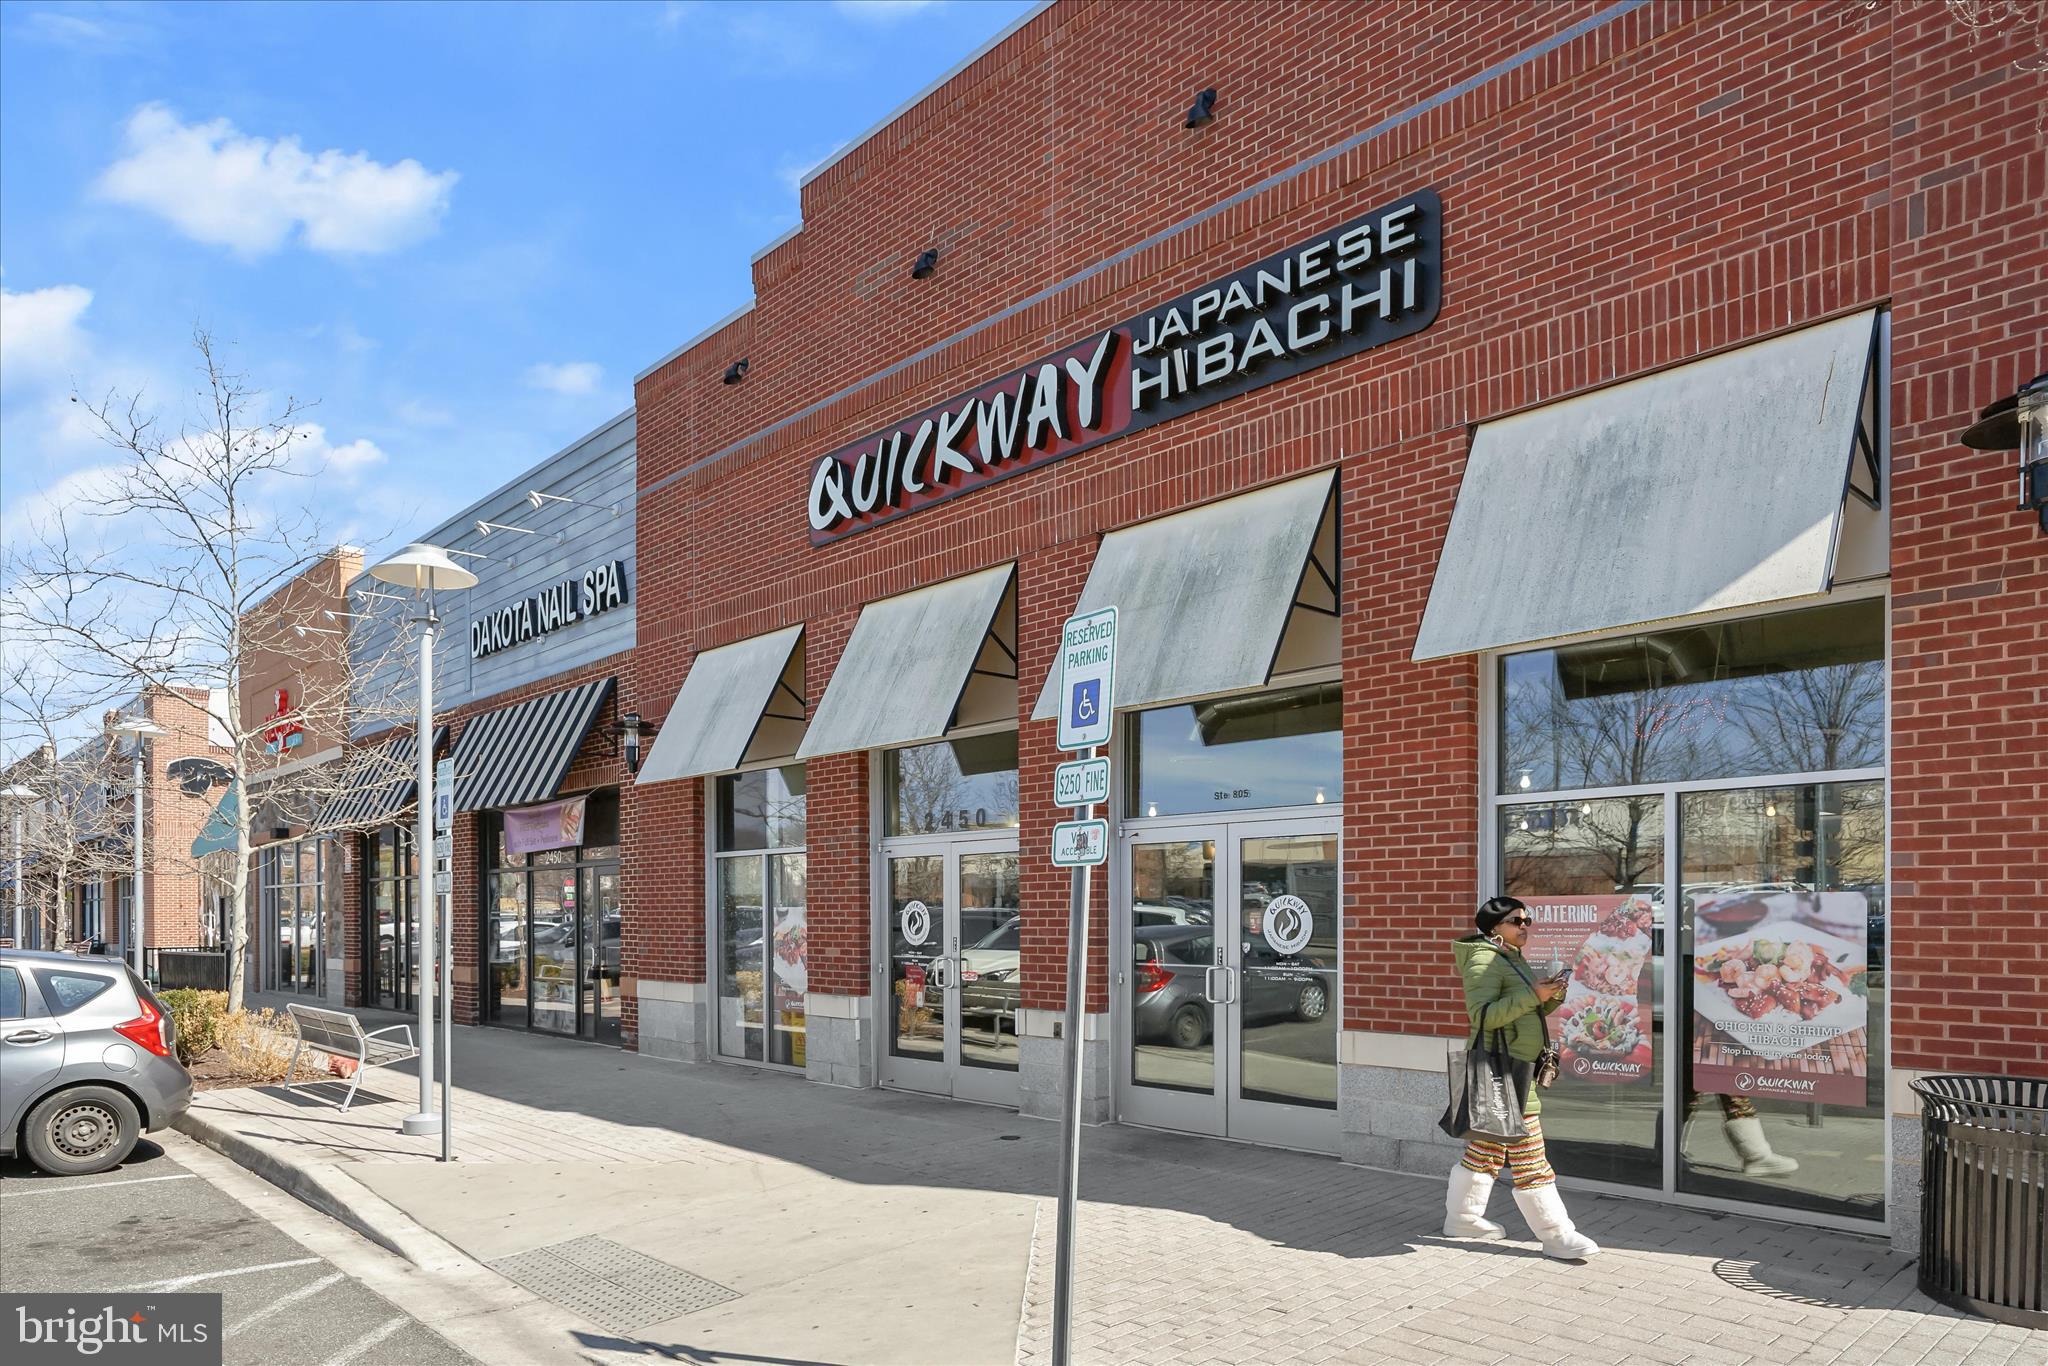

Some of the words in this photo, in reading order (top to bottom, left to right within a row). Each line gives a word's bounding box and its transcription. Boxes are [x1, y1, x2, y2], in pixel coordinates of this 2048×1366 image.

[1133, 204, 1416, 355] JAPANESE
[1131, 258, 1416, 410] HIBACHI
[808, 330, 1112, 530] QUICKWAY
[471, 597, 533, 659] DAKOTA
[537, 580, 577, 634] NAIL
[583, 560, 621, 616] SPA
[1066, 621, 1113, 648] RESERVED
[1068, 645, 1109, 669] PARKING
[1059, 773, 1081, 797] $250
[1085, 769, 1105, 792] FINE
[1232, 789, 1249, 798] 805
[924, 808, 986, 832] 2450
[545, 851, 562, 865] 2450
[1535, 904, 1598, 923] CATERING
[1714, 1021, 1774, 1035] CHICKEN
[1776, 1024, 1787, 1035] &
[1789, 1025, 1842, 1038] SHRIMP
[1748, 1035, 1805, 1047] HIBACHI
[1721, 1046, 1740, 1056] Stop
[1742, 1047, 1752, 1056] in
[1752, 1048, 1770, 1057] and
[1771, 1050, 1783, 1059] try
[1786, 1051, 1802, 1060] one
[1804, 1052, 1832, 1062] today.
[1591, 1060, 1642, 1073] QUICKWAY
[1757, 1076, 1817, 1090] QUICKWAY
